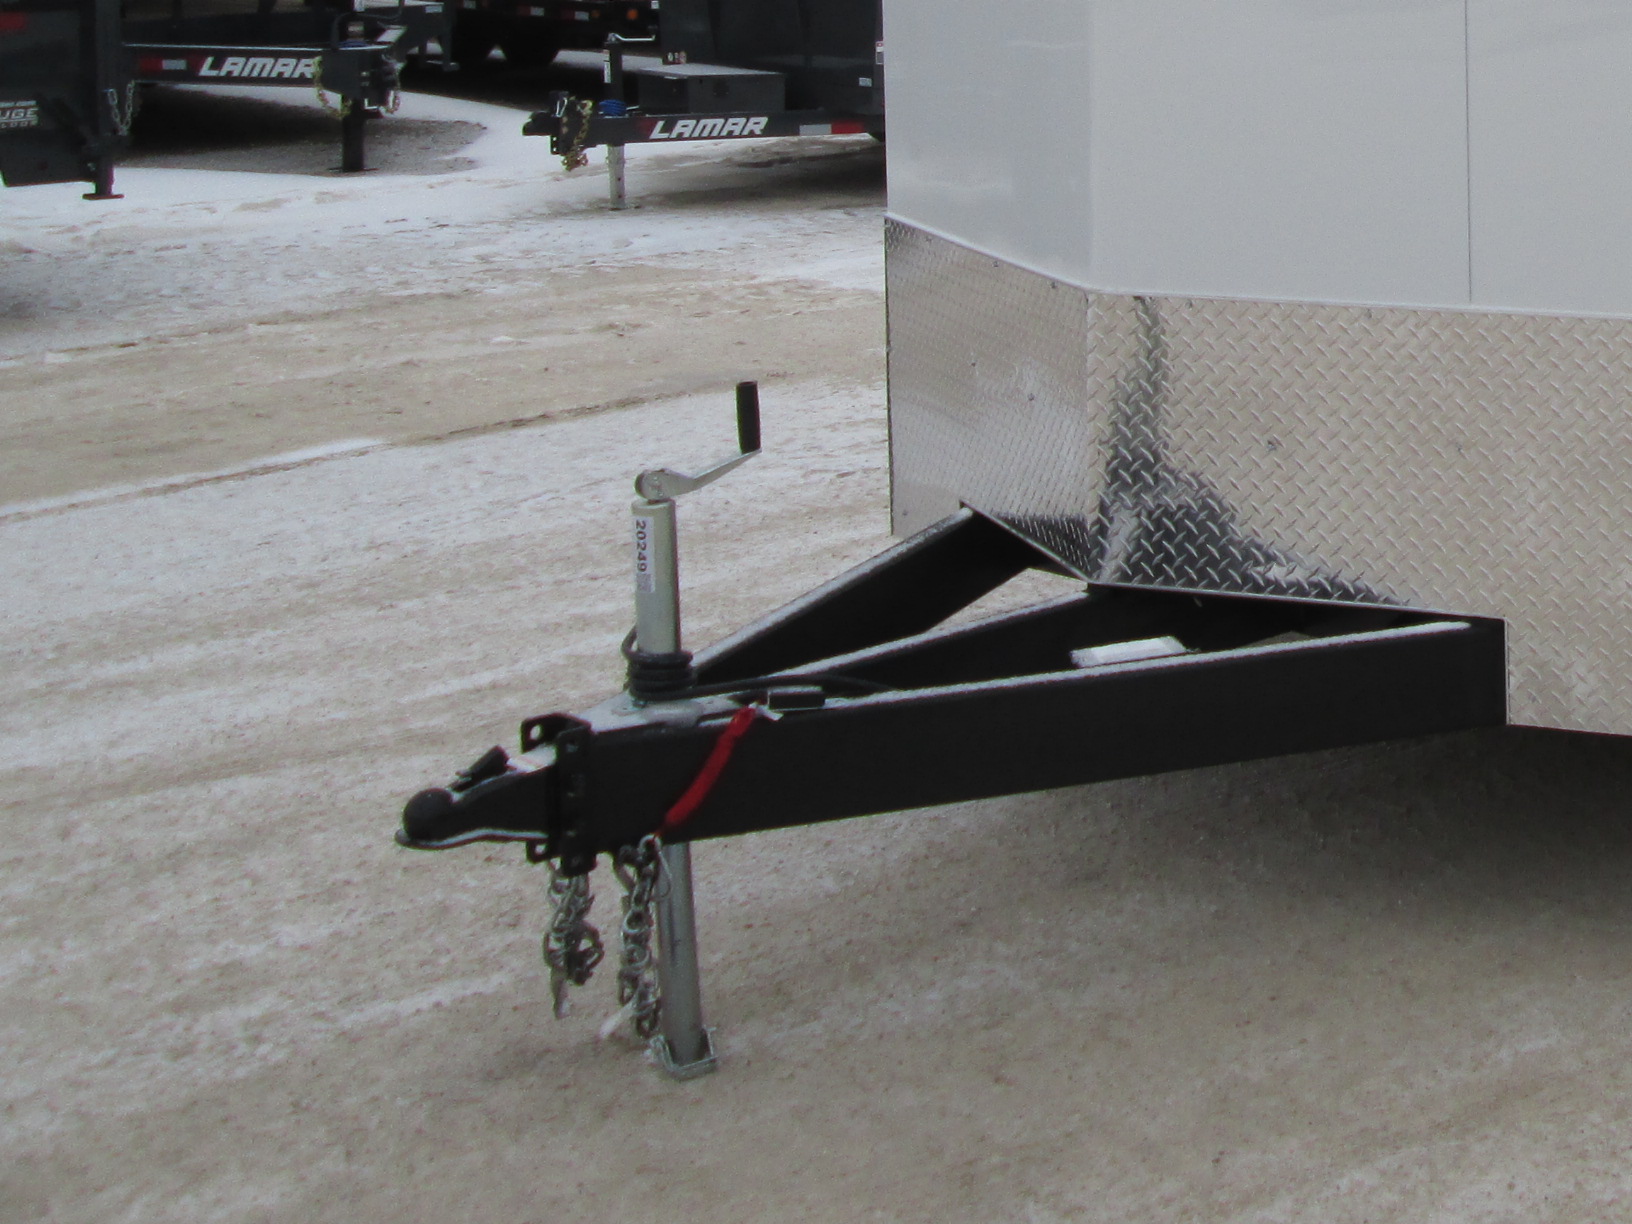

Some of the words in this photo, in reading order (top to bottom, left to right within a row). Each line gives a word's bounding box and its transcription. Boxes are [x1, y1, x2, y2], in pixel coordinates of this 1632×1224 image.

[198, 56, 317, 78] LAMAR
[649, 116, 768, 139] LAMAR
[635, 519, 647, 572] 20249
